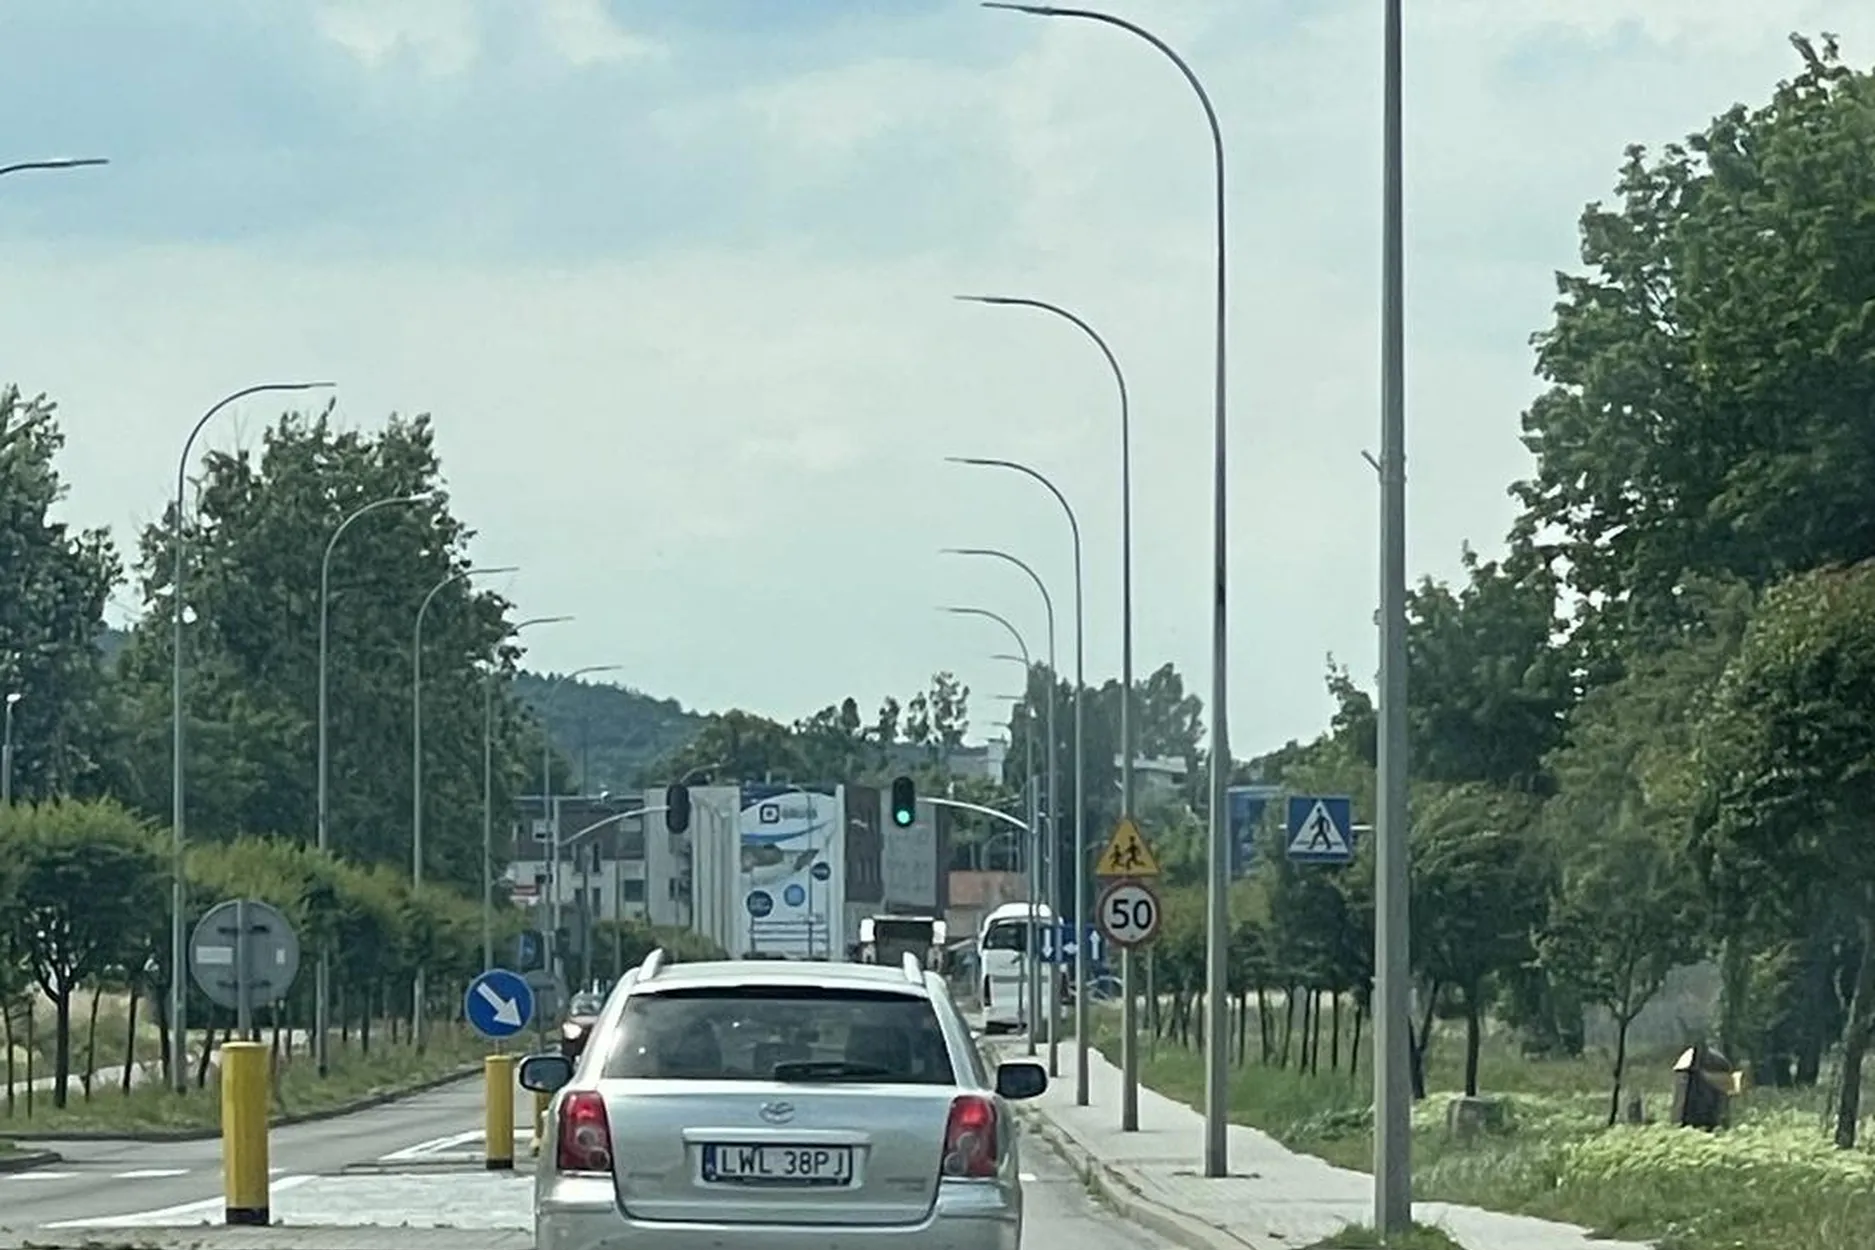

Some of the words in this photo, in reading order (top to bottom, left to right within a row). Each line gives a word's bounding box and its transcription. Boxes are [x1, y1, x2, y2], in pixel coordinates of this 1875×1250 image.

[1110, 898, 1153, 930] 50
[721, 1148, 773, 1174] LWL
[783, 1150, 844, 1176] 38PJ
